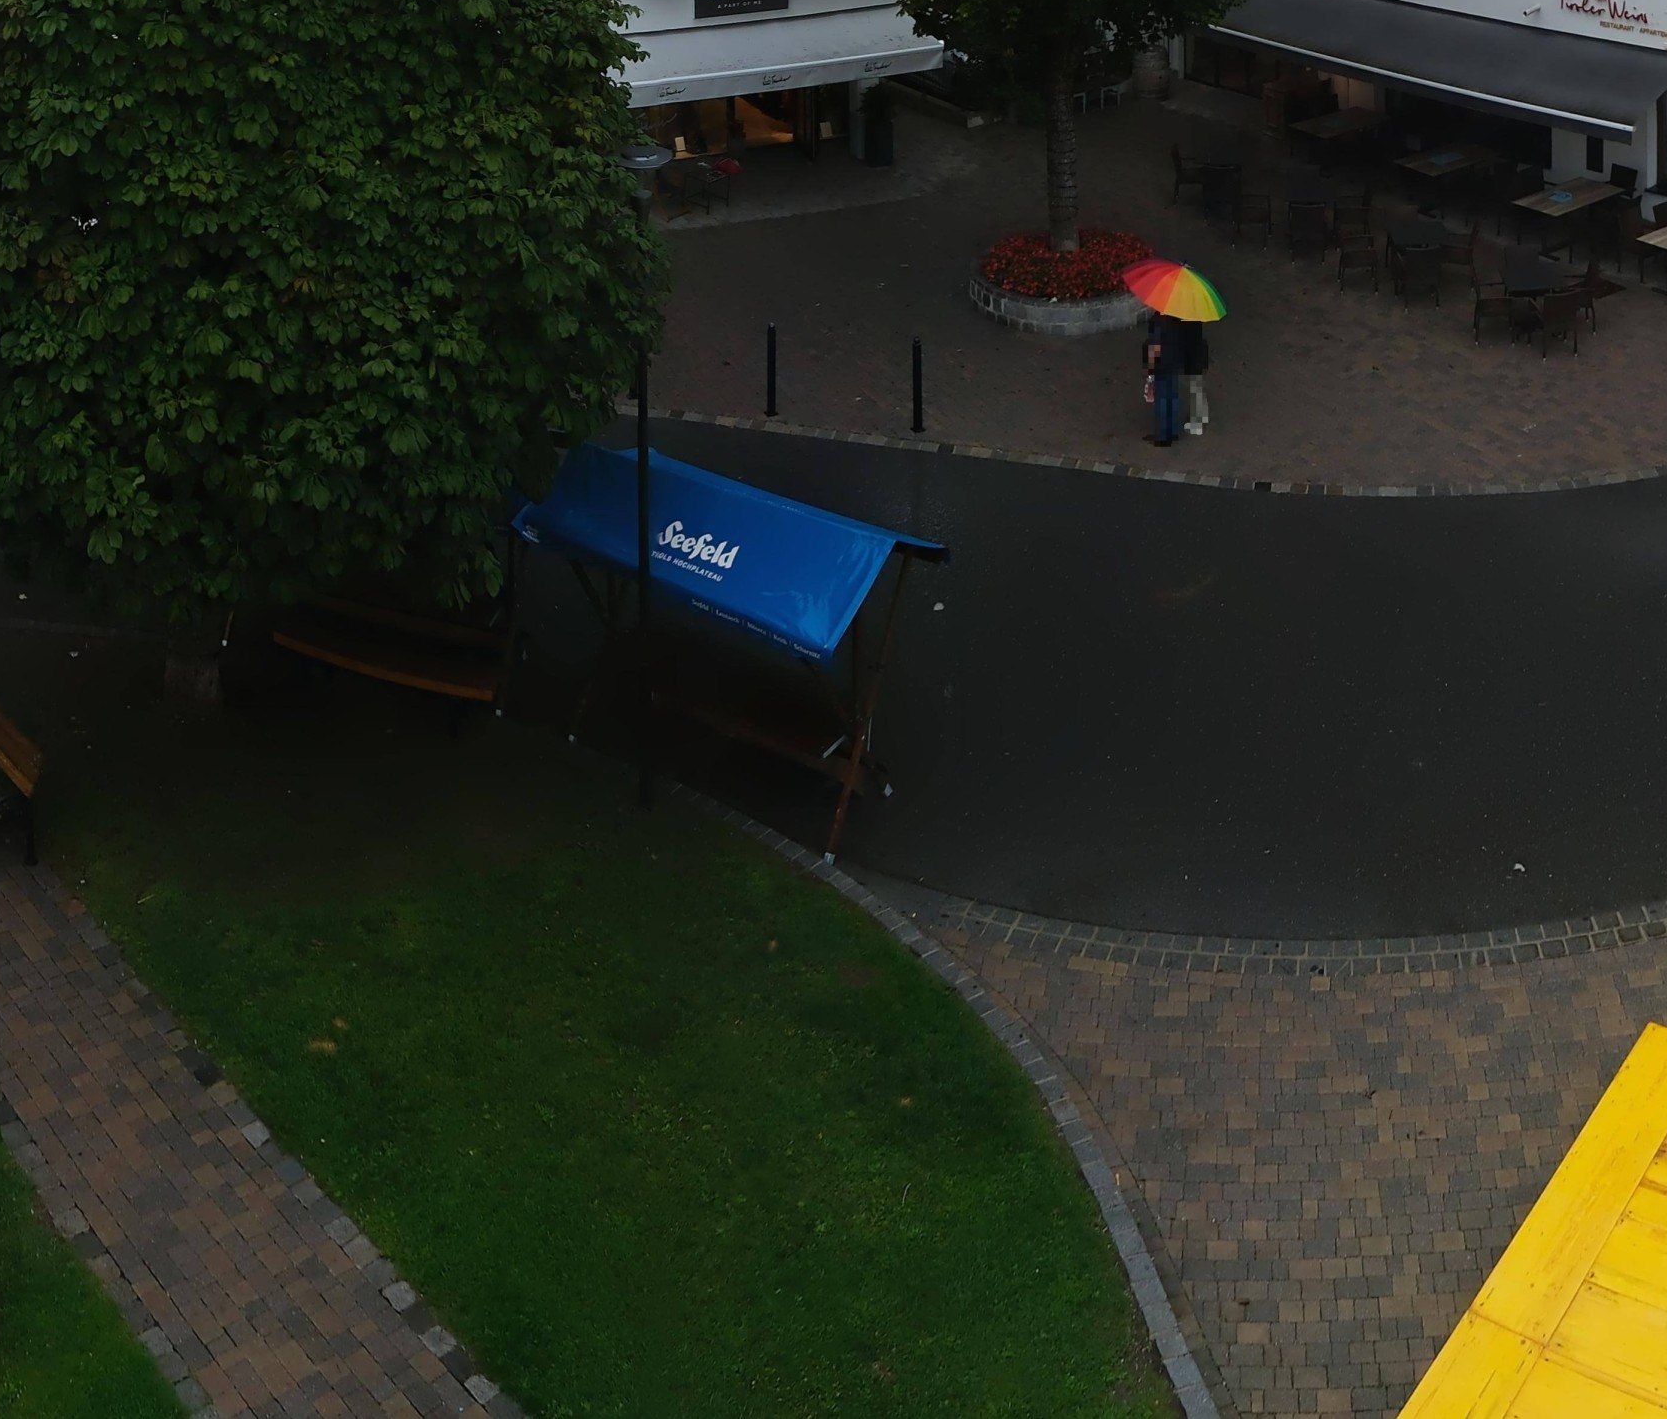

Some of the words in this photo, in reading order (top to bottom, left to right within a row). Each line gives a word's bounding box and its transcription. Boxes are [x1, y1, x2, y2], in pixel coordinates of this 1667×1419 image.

[1599, 21, 1634, 32] RESTAURANT
[657, 520, 740, 569] Seefeld
[672, 557, 723, 582] HOCHPLATEAU
